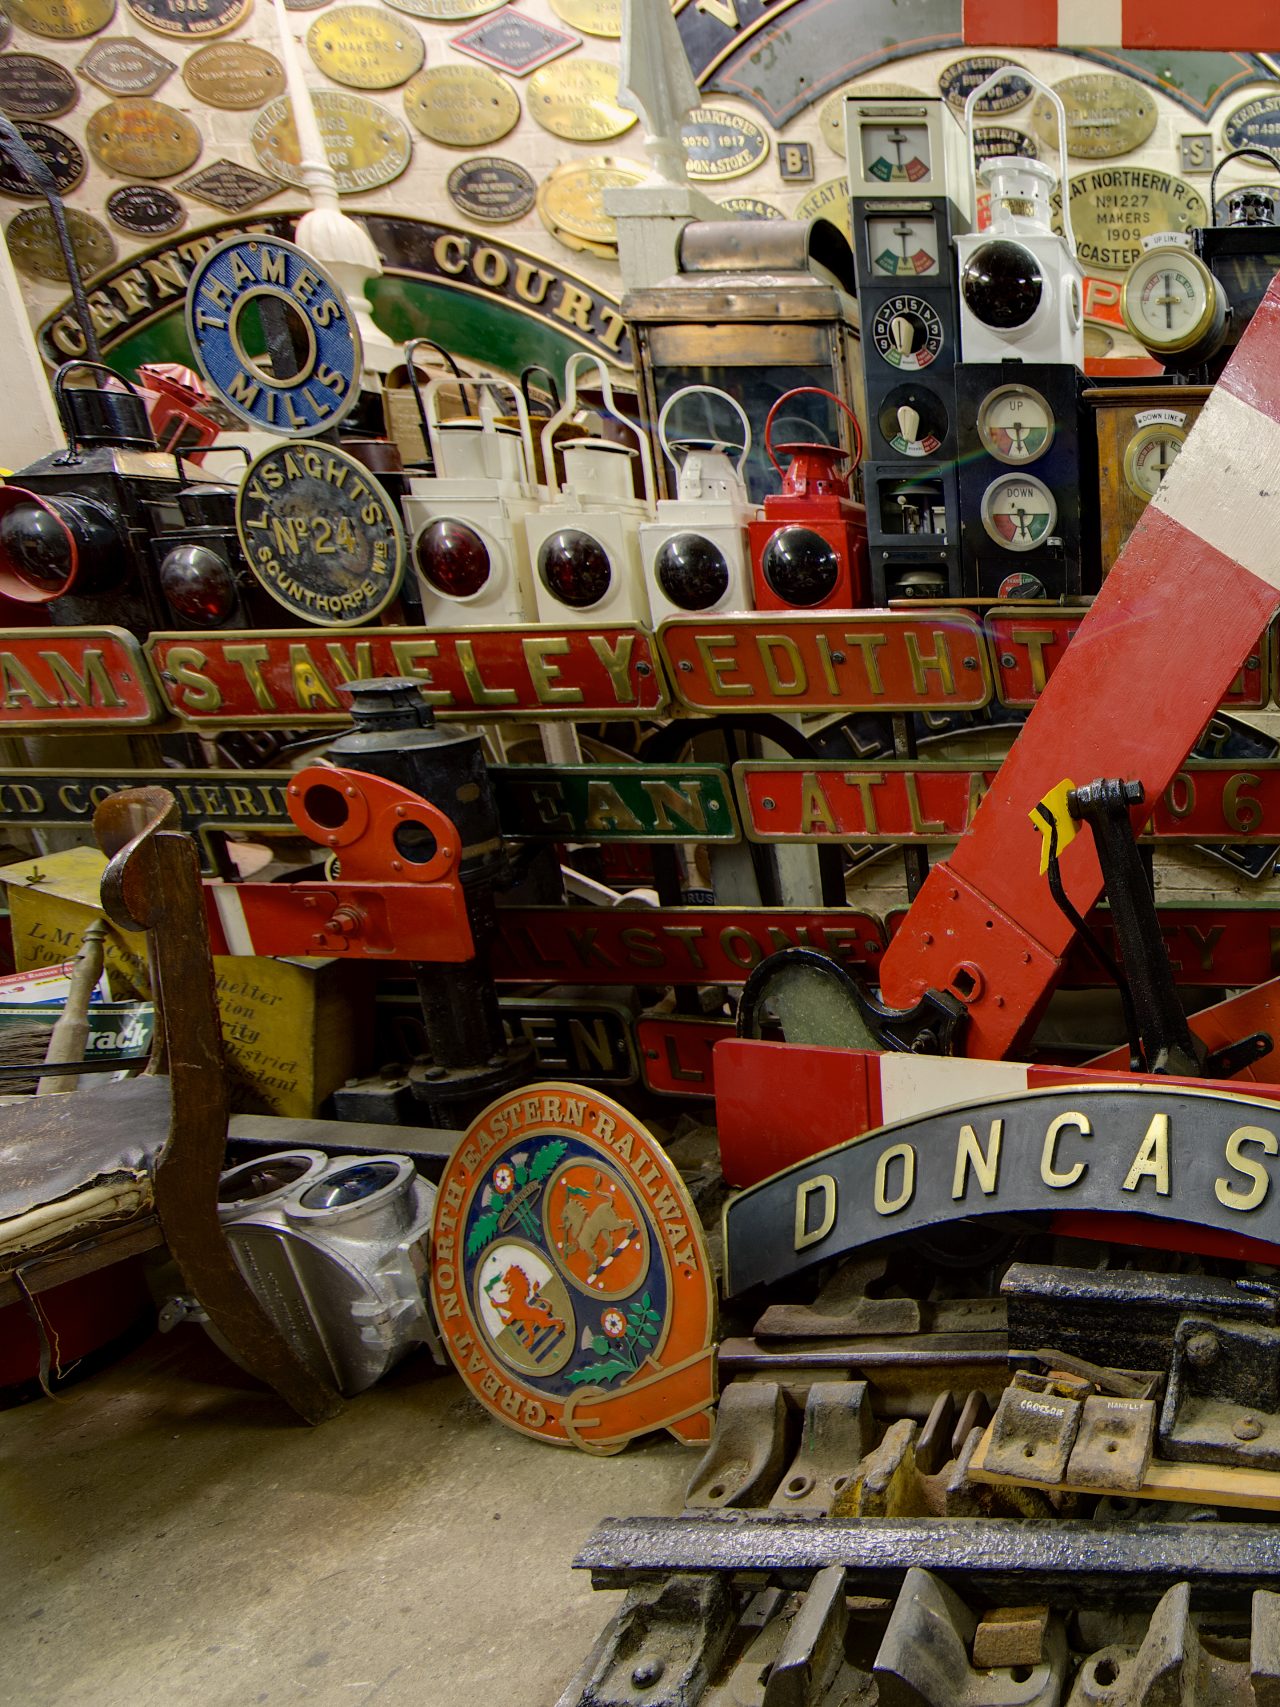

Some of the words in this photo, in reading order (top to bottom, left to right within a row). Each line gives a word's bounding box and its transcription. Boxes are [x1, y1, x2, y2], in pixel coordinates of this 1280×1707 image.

[718, 135, 745, 147] 1917
[786, 147, 802, 173] B
[1190, 140, 1205, 166] S
[1092, 170, 1172, 194] NORTHERN
[1097, 213, 1150, 224] MAKERS
[1107, 229, 1141, 241] 1909
[1154, 236, 1163, 244] UP
[1163, 235, 1178, 243] LINE
[196, 250, 342, 332] THAMES
[434, 234, 634, 357] COURT
[883, 309, 891, 318] 7
[895, 300, 903, 310] 6
[911, 300, 918, 310] 5
[923, 309, 931, 318] 4
[877, 323, 885, 333] 8
[931, 324, 939, 335] 3
[880, 340, 888, 350] 9
[929, 340, 937, 350] 2
[226, 364, 348, 428] MILLS
[1009, 401, 1024, 411] UP
[1142, 413, 1162, 423] DOWN
[1163, 413, 1178, 423] LINE
[247, 452, 383, 530] LYSAGHT'S
[1007, 488, 1034, 498] DOWN
[258, 546, 377, 612] SCUNTHORPE
[165, 635, 635, 711] STAVELEY
[696, 634, 956, 697] EDITH
[86, 1023, 150, 1051] rack
[458, 1096, 588, 1175] EASTERN
[592, 1110, 699, 1273] RAILWAY
[436, 1177, 467, 1322] NORTH
[453, 1331, 547, 1429] GREAT
